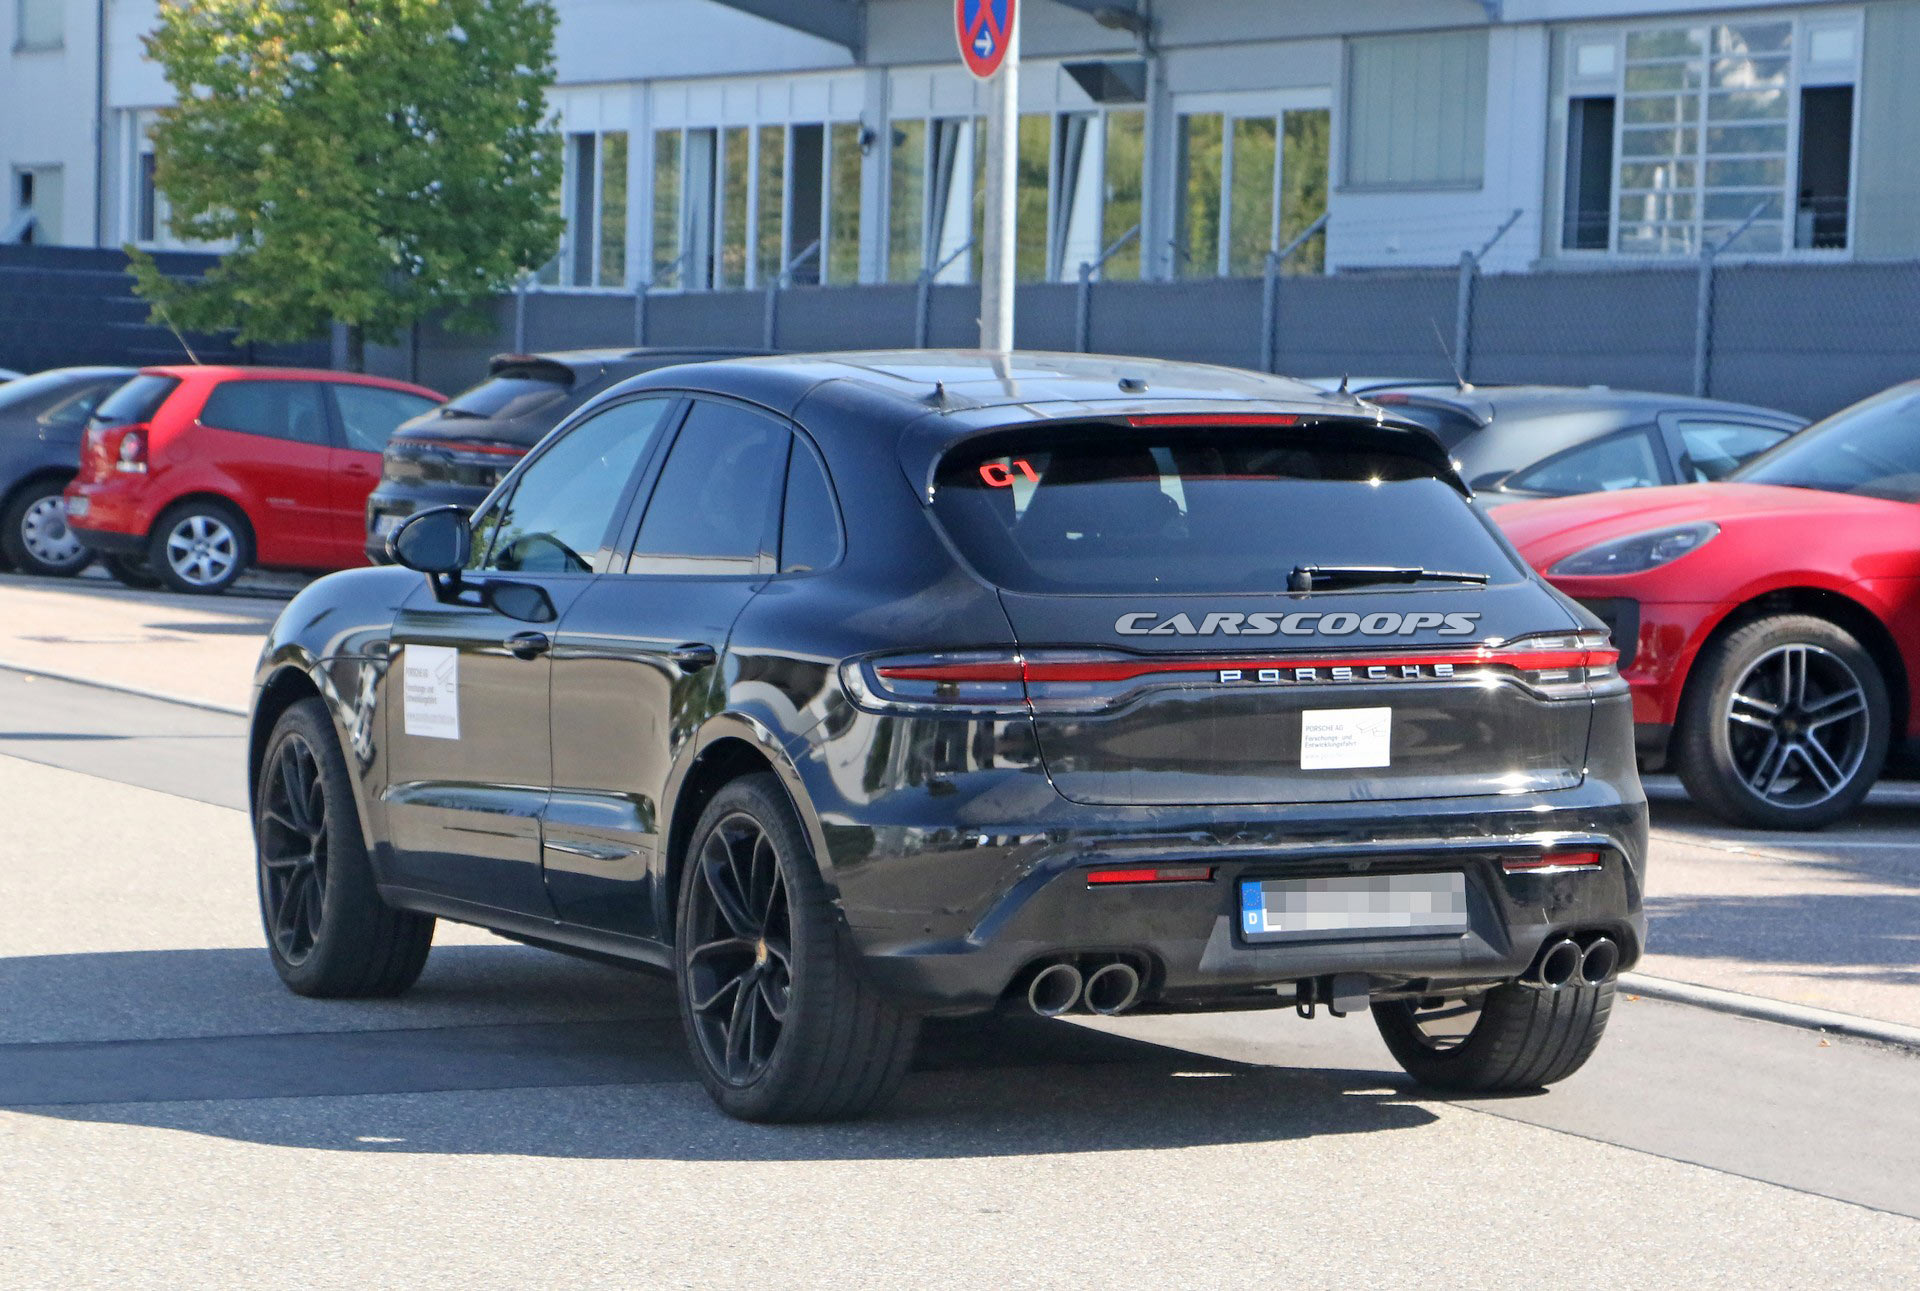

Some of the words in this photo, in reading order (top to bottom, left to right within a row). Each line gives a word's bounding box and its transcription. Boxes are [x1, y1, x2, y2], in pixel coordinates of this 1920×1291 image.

[979, 460, 1040, 487] C1
[1219, 663, 1455, 684] PORSCHE
[1248, 912, 1258, 925] D
